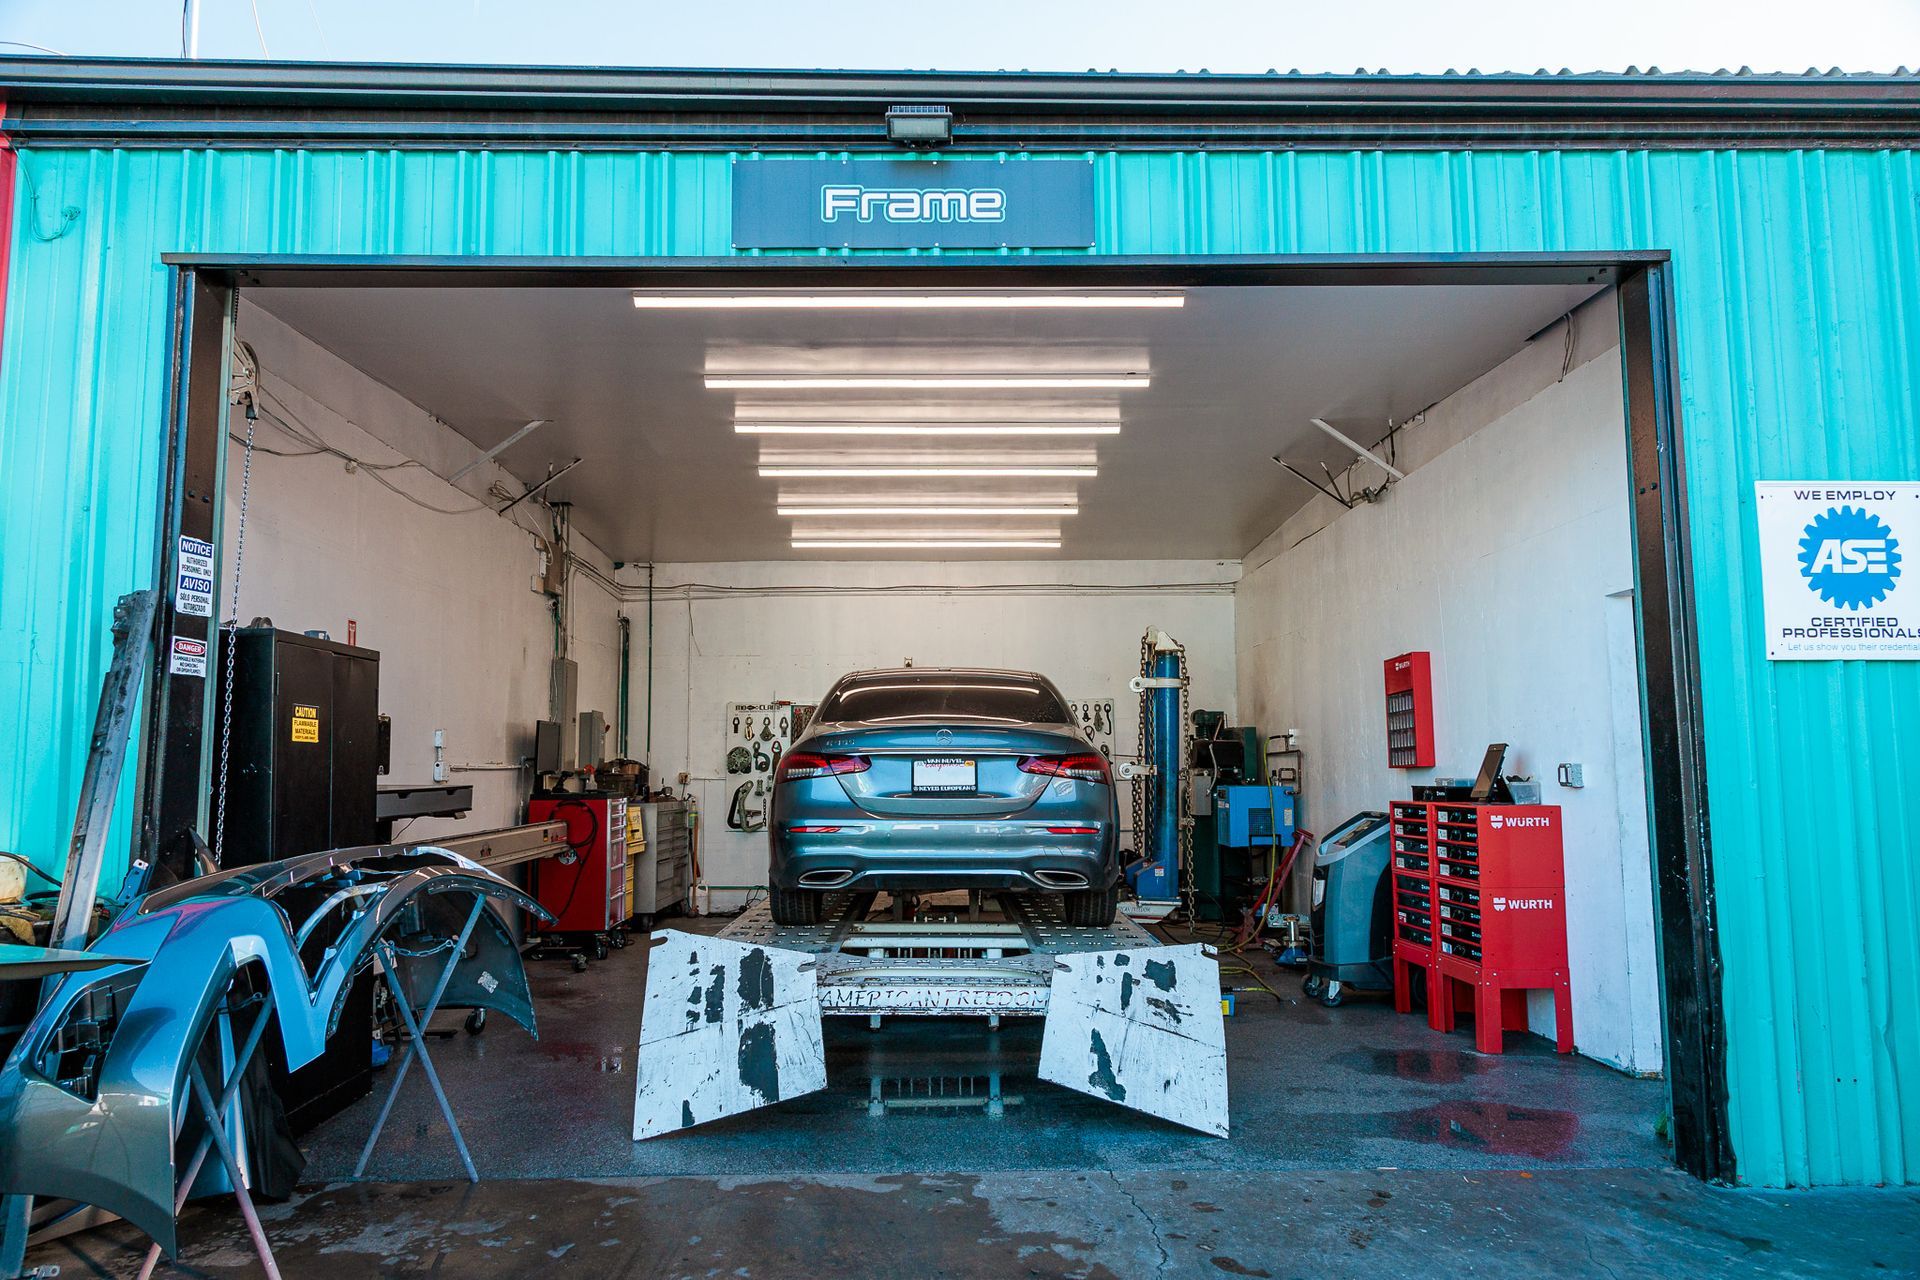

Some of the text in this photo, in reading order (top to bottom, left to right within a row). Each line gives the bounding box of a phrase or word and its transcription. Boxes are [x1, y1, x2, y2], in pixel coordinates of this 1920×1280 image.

[821, 185, 1006, 222] Frame
[1794, 490, 1896, 500] WE EMPLOY
[182, 540, 211, 556] NOTICE
[186, 556, 208, 567] AUTHORIZED
[1810, 538, 1888, 574] ASE
[182, 564, 211, 577] PERSONNEL ONLY
[182, 577, 210, 592] AVISO
[190, 593, 210, 604] PERSONAL
[183, 602, 206, 613] AUTORIZADO
[1811, 617, 1899, 627] CERTIFIED
[1782, 628, 1920, 638] PROFESSIONAL
[178, 643, 202, 653] DANGER
[1788, 643, 1801, 651] Let
[1816, 643, 1839, 651] show
[1841, 644, 1856, 653] you
[1858, 643, 1877, 651] their
[294, 706, 317, 718] CAUTION
[1505, 817, 1550, 827] WÜRTH
[1508, 899, 1553, 909] WÜRTH
